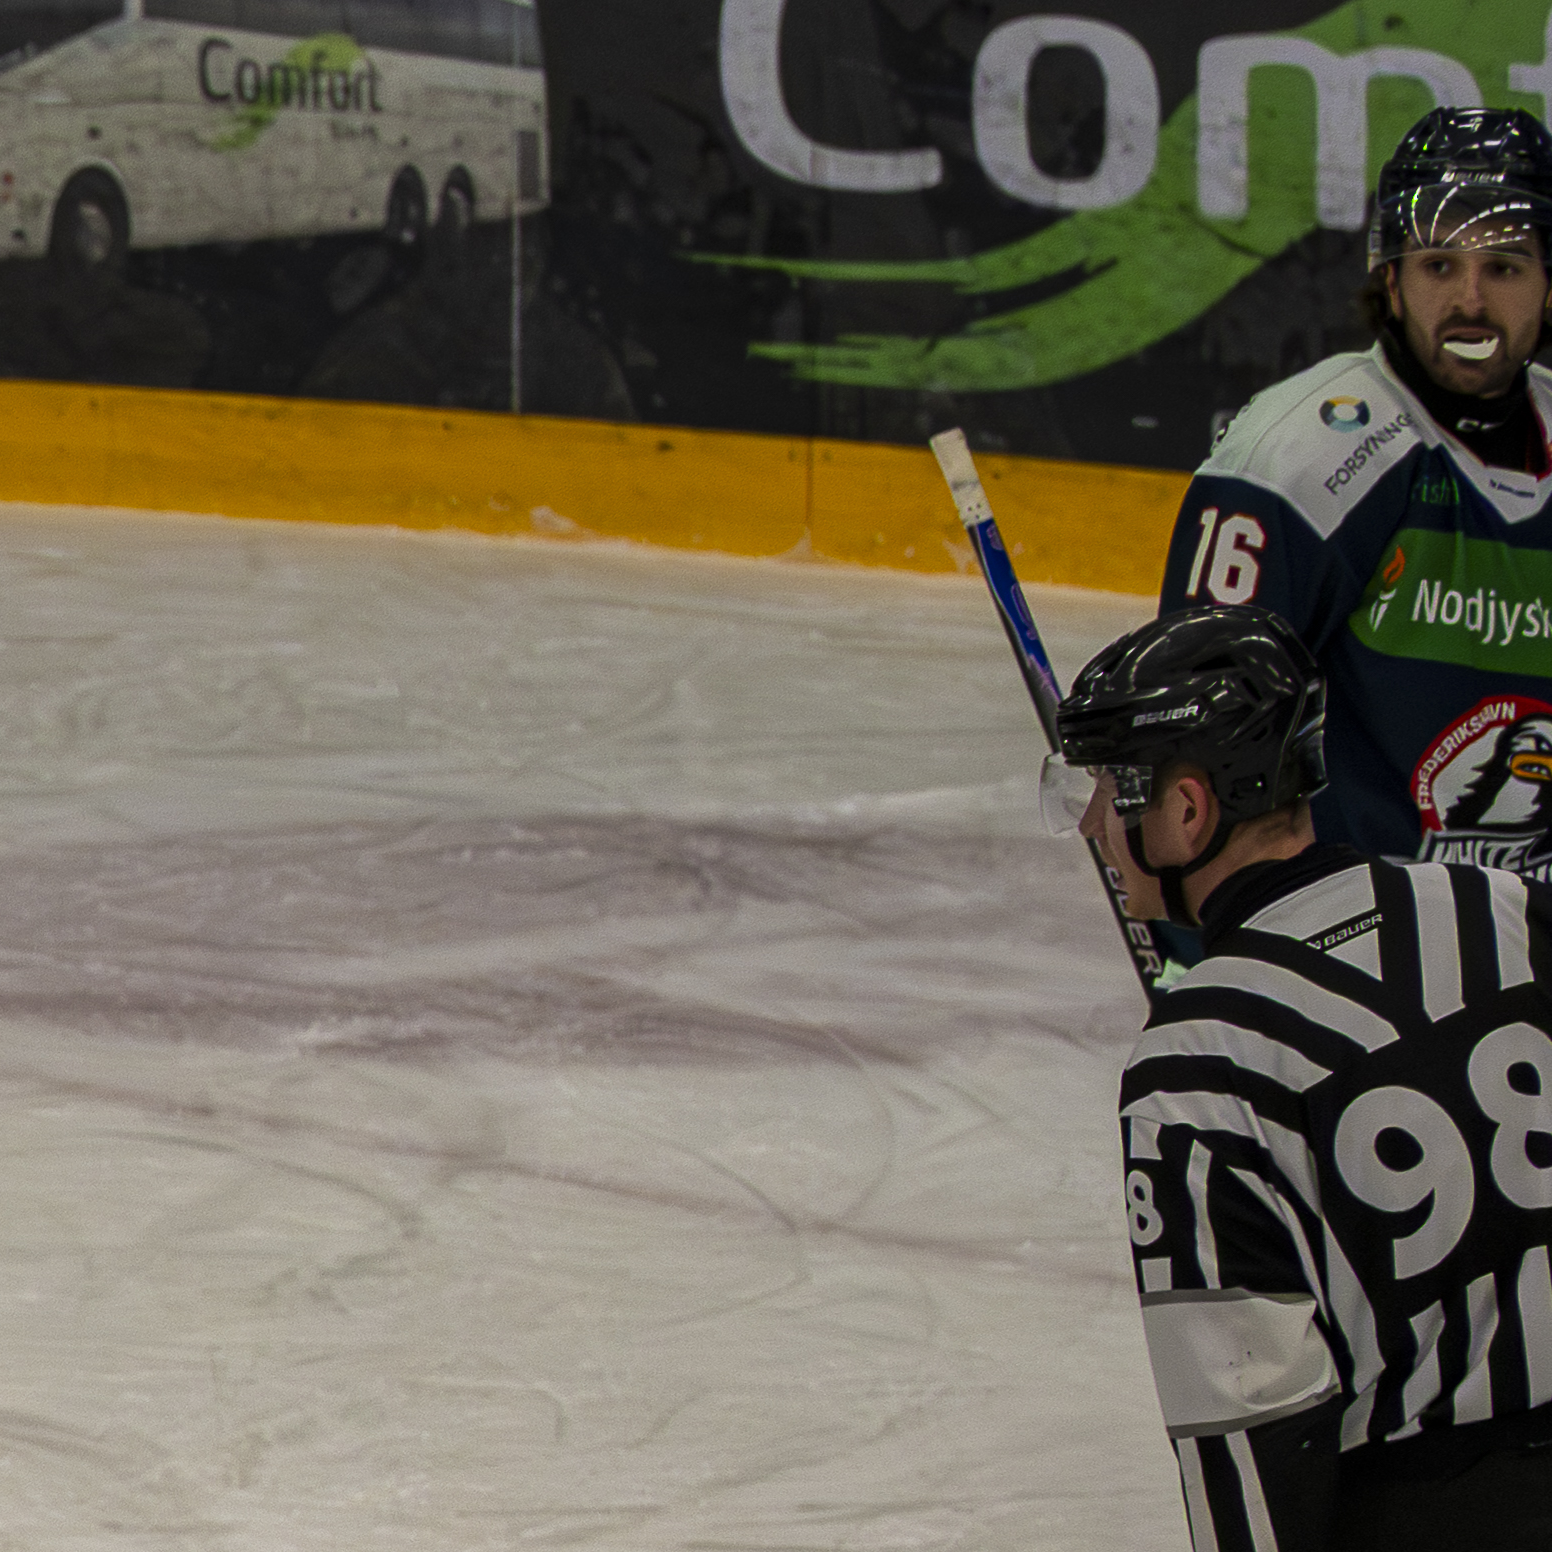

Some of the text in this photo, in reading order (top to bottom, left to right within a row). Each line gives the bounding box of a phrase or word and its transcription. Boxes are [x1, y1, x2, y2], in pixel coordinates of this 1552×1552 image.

[199, 36, 384, 113] Comfort
[719, 0, 1552, 231] Com
[1183, 507, 1265, 605] 16
[1322, 912, 1383, 949] BAUER
[1333, 1020, 1552, 1281] 98
